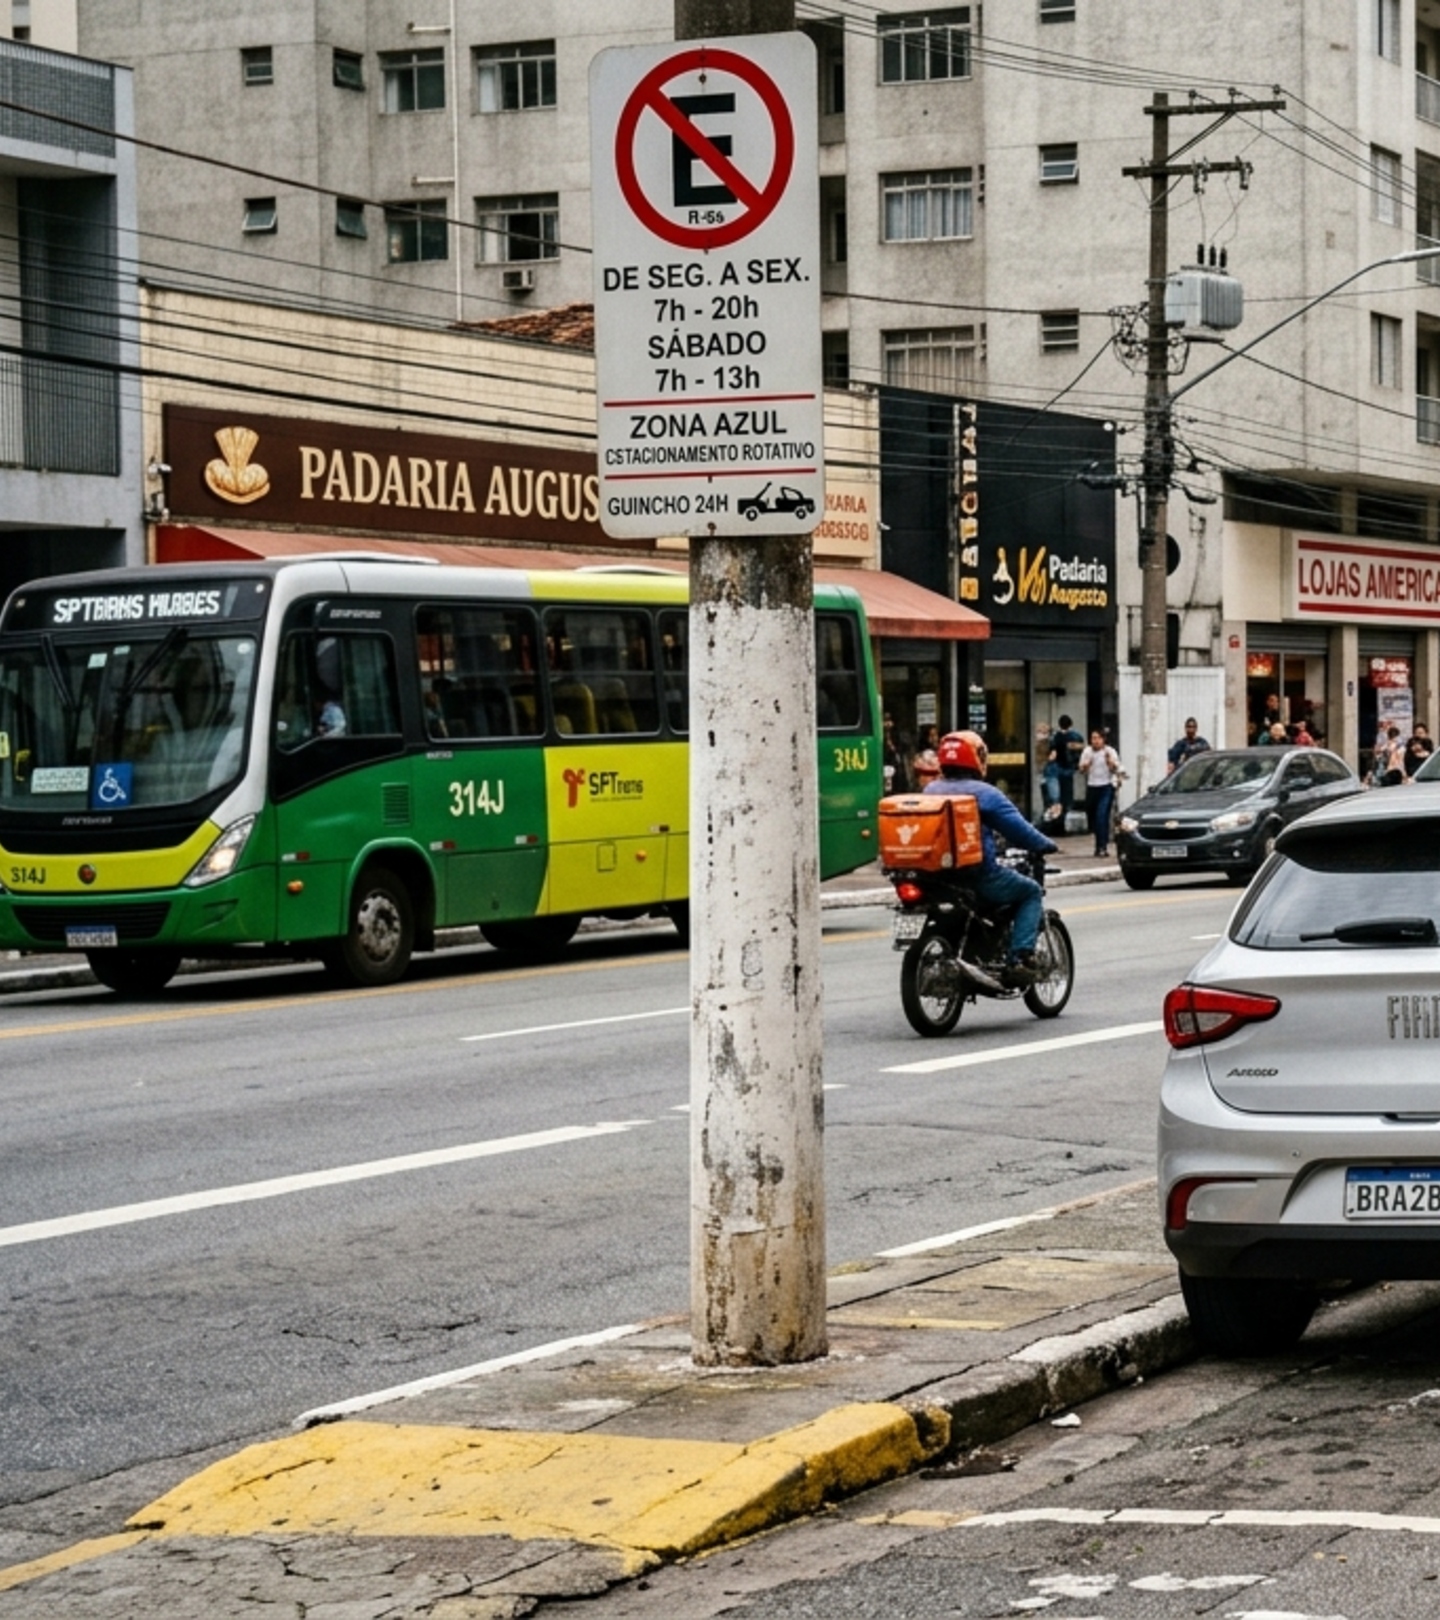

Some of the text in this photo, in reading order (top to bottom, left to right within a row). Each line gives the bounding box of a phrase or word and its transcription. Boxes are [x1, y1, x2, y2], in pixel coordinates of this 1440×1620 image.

[603, 257, 810, 291] DE SEG. A SEX.
[654, 298, 685, 323] 7h
[711, 295, 759, 320] 20h
[648, 327, 766, 359] SÁBADO
[655, 368, 686, 392] 7h
[713, 365, 760, 390] 13h
[630, 410, 787, 439] ZONA AZUL
[743, 442, 815, 461] ROTATIVO
[299, 446, 477, 513] PADARIA
[608, 494, 728, 515] GUINCHO 24H
[1299, 558, 1361, 597] LOJAS
[449, 780, 505, 816] 314J
